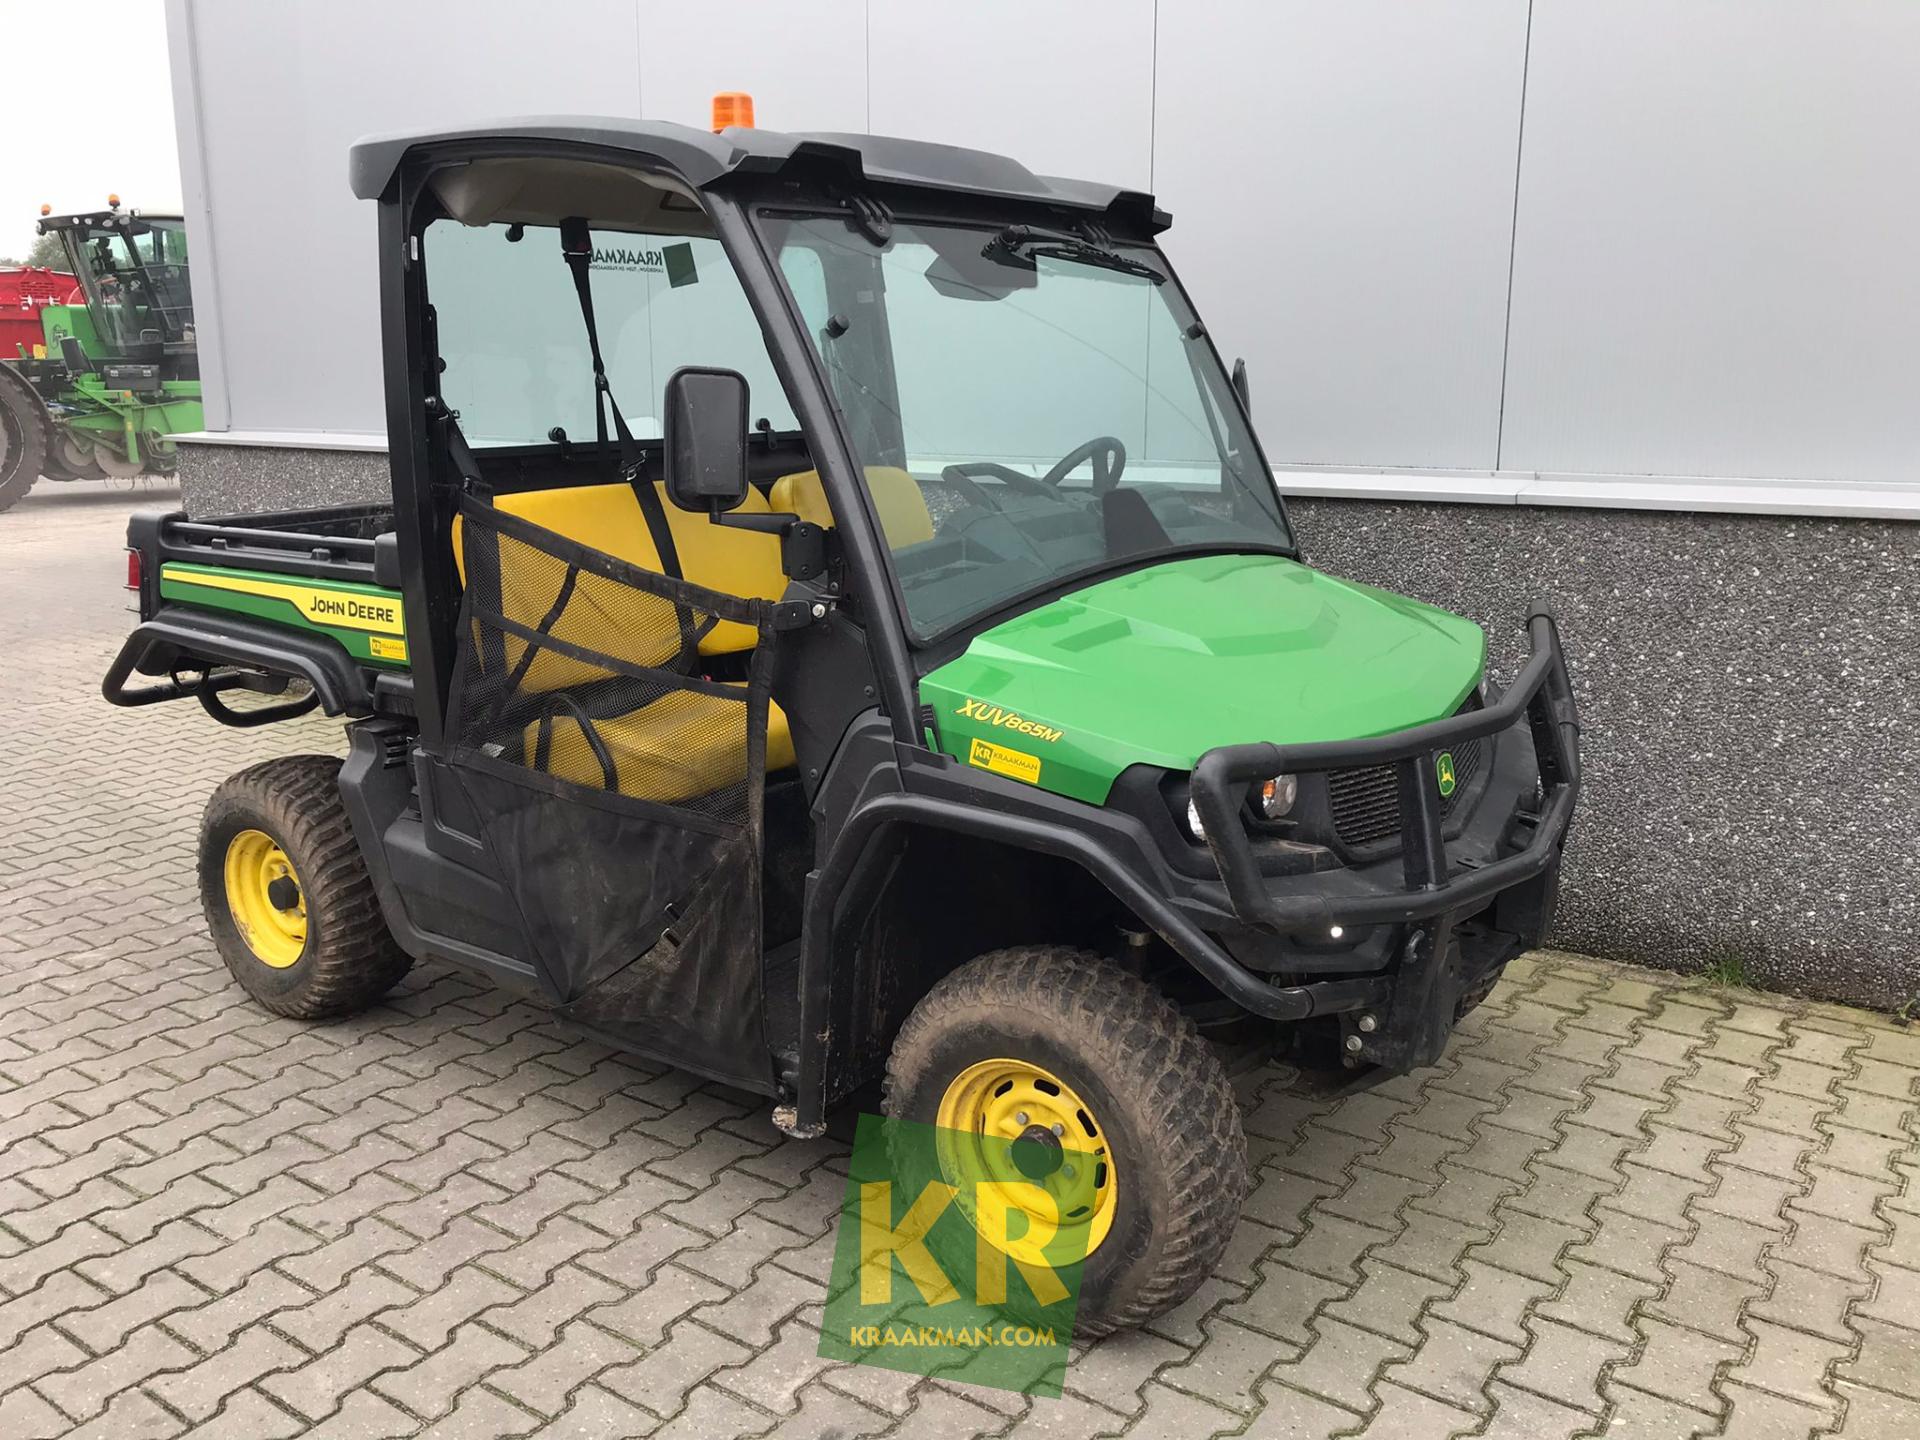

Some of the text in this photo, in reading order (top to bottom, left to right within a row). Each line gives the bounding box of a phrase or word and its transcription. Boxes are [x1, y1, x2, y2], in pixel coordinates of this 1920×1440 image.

[310, 596, 394, 623] JOHN DEERE
[955, 699, 1064, 742] XUV865M
[975, 745, 1038, 771] KR KRAAKMAN
